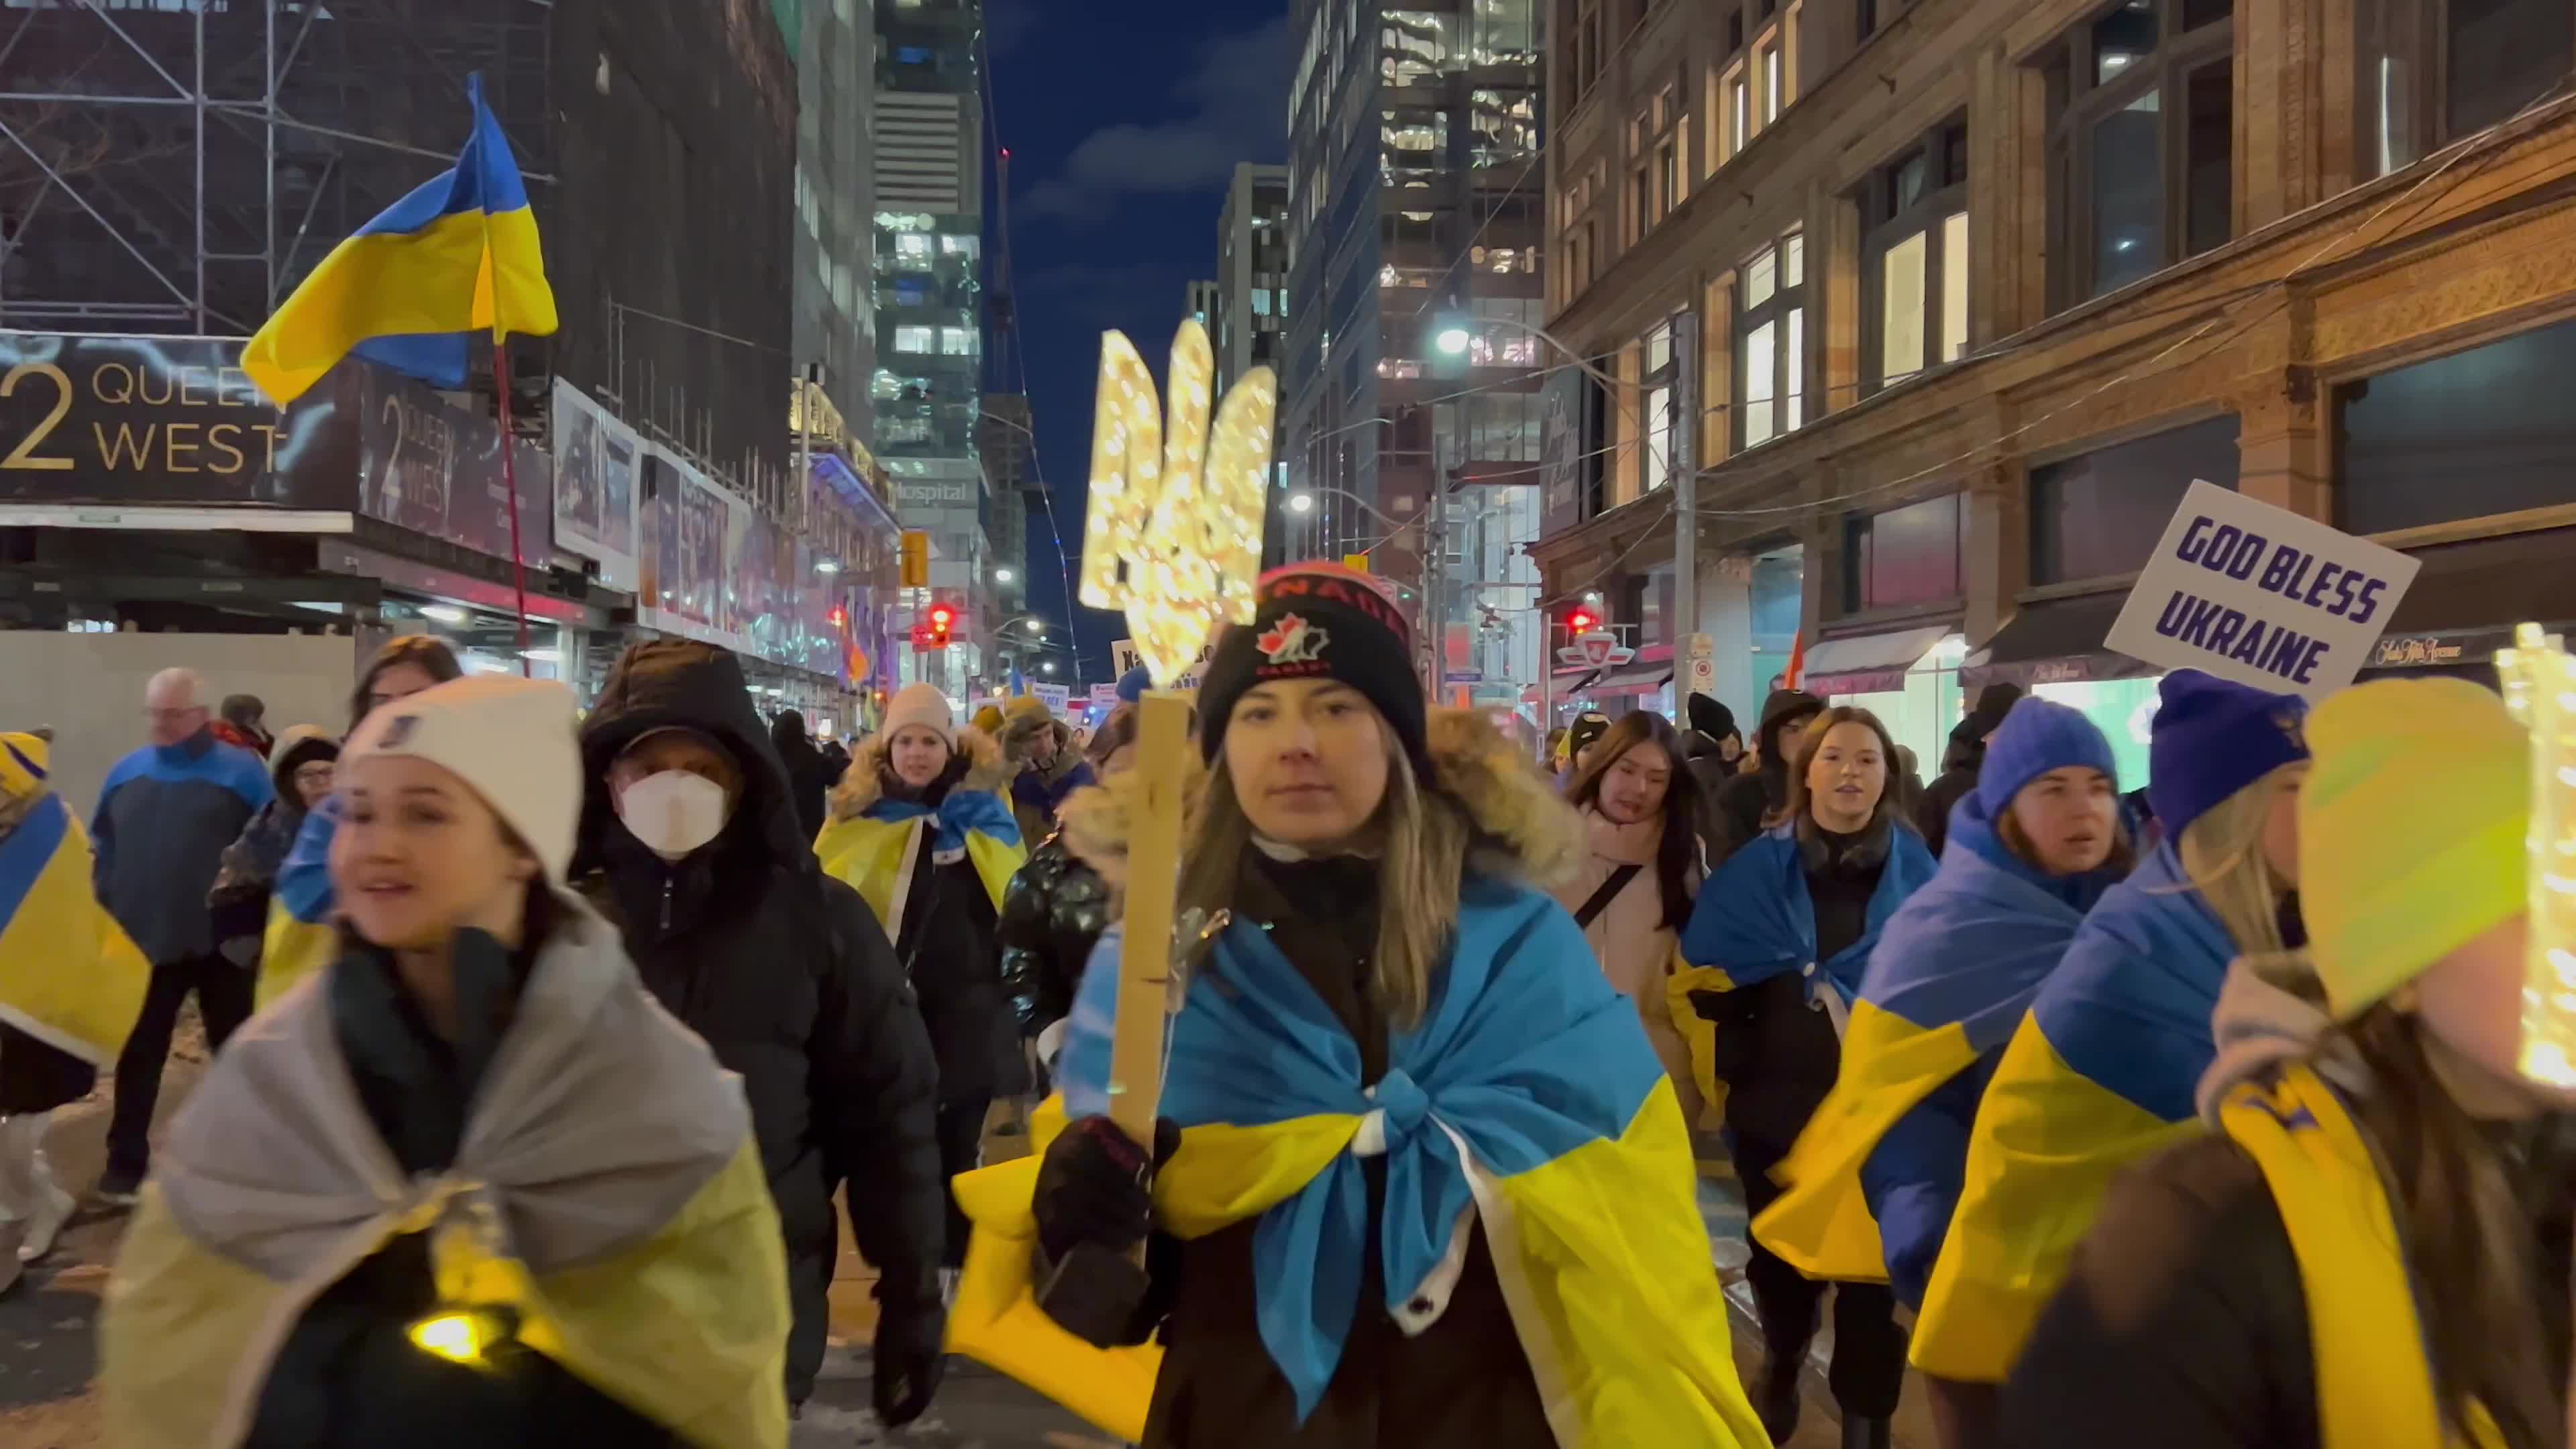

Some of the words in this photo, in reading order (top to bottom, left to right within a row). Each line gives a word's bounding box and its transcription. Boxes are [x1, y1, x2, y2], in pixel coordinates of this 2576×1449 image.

[0, 363, 74, 470] 2
[93, 363, 269, 407] QUEE
[93, 423, 286, 474] WEST
[2176, 515, 2268, 580] GOD
[2257, 545, 2387, 624] BLESS
[2155, 590, 2330, 685] UKRAINE
